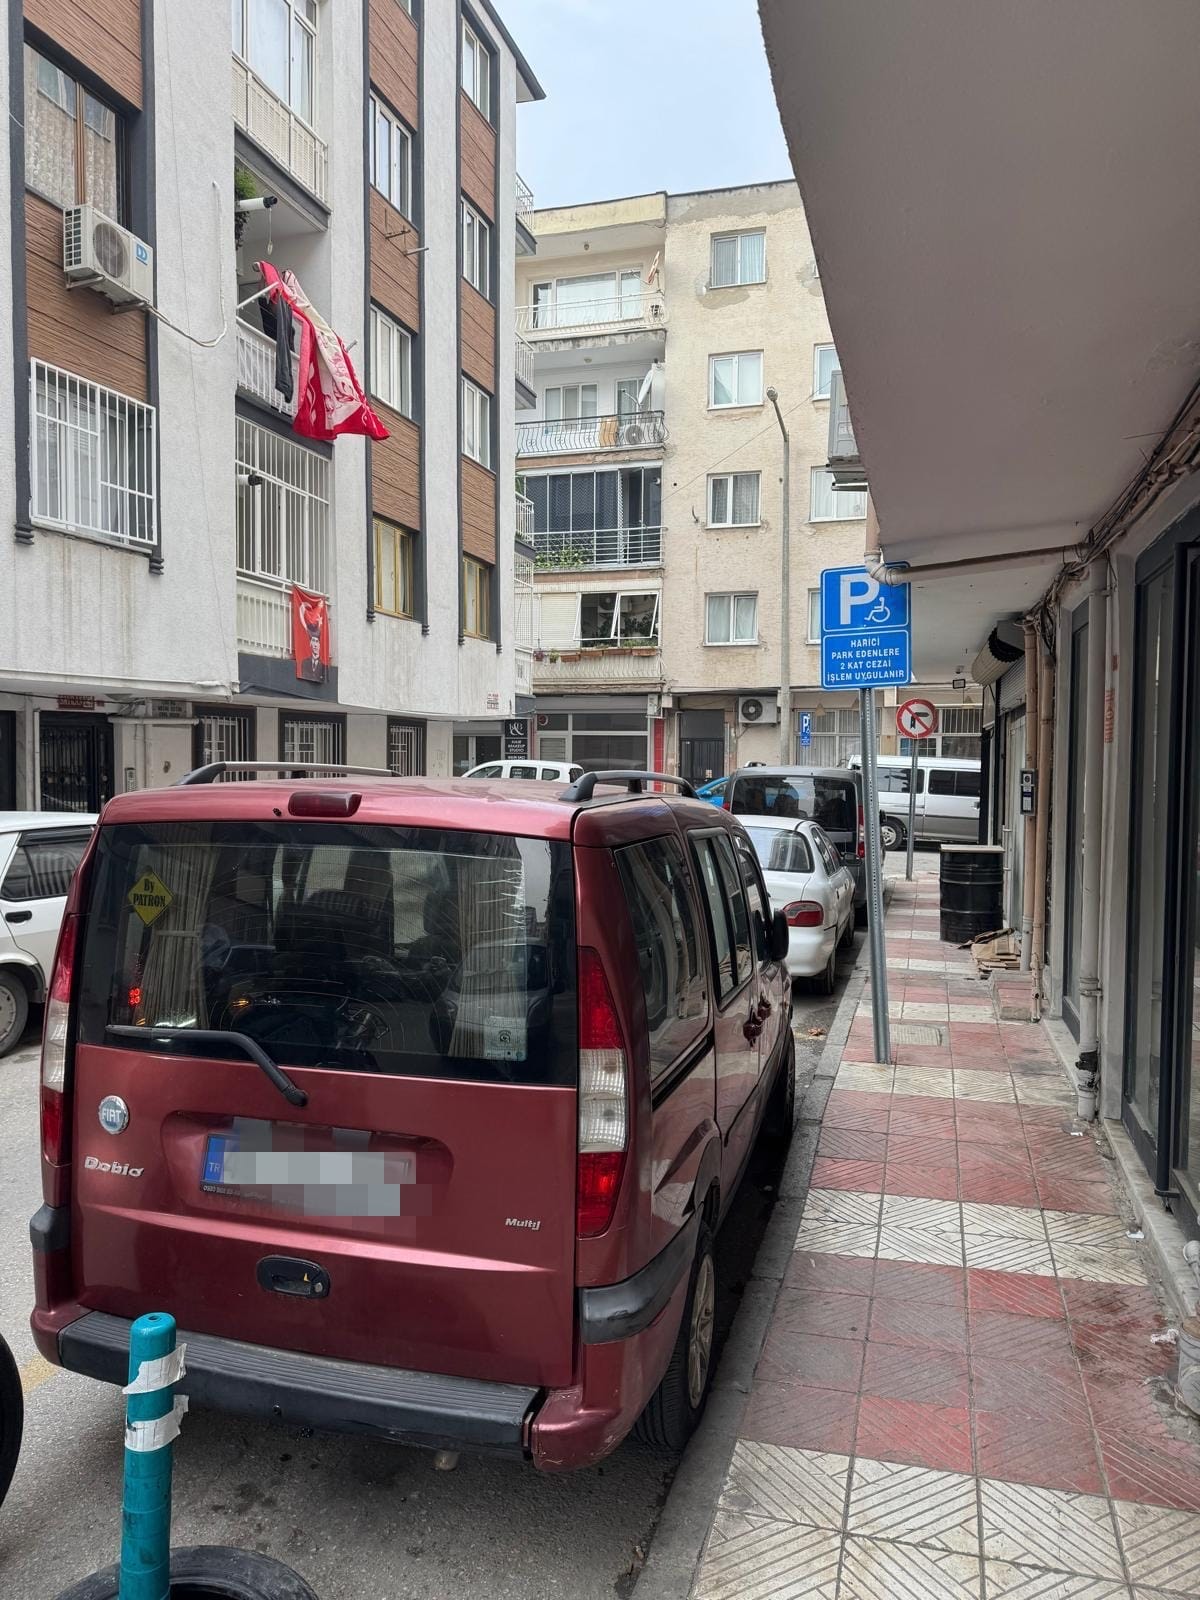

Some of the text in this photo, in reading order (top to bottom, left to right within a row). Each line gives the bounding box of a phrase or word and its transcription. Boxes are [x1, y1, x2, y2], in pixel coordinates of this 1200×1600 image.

[840, 572, 880, 625] P
[850, 635, 880, 648] HARİCİ
[831, 647, 900, 660] PARK EDENLERE
[840, 662, 846, 670] 2
[847, 661, 864, 670] KAT
[854, 669, 905, 680] UYGULANIR
[144, 878, 154, 894] By
[133, 893, 166, 907] PATRON
[102, 1108, 121, 1122] FIAT
[208, 1162, 220, 1173] TR
